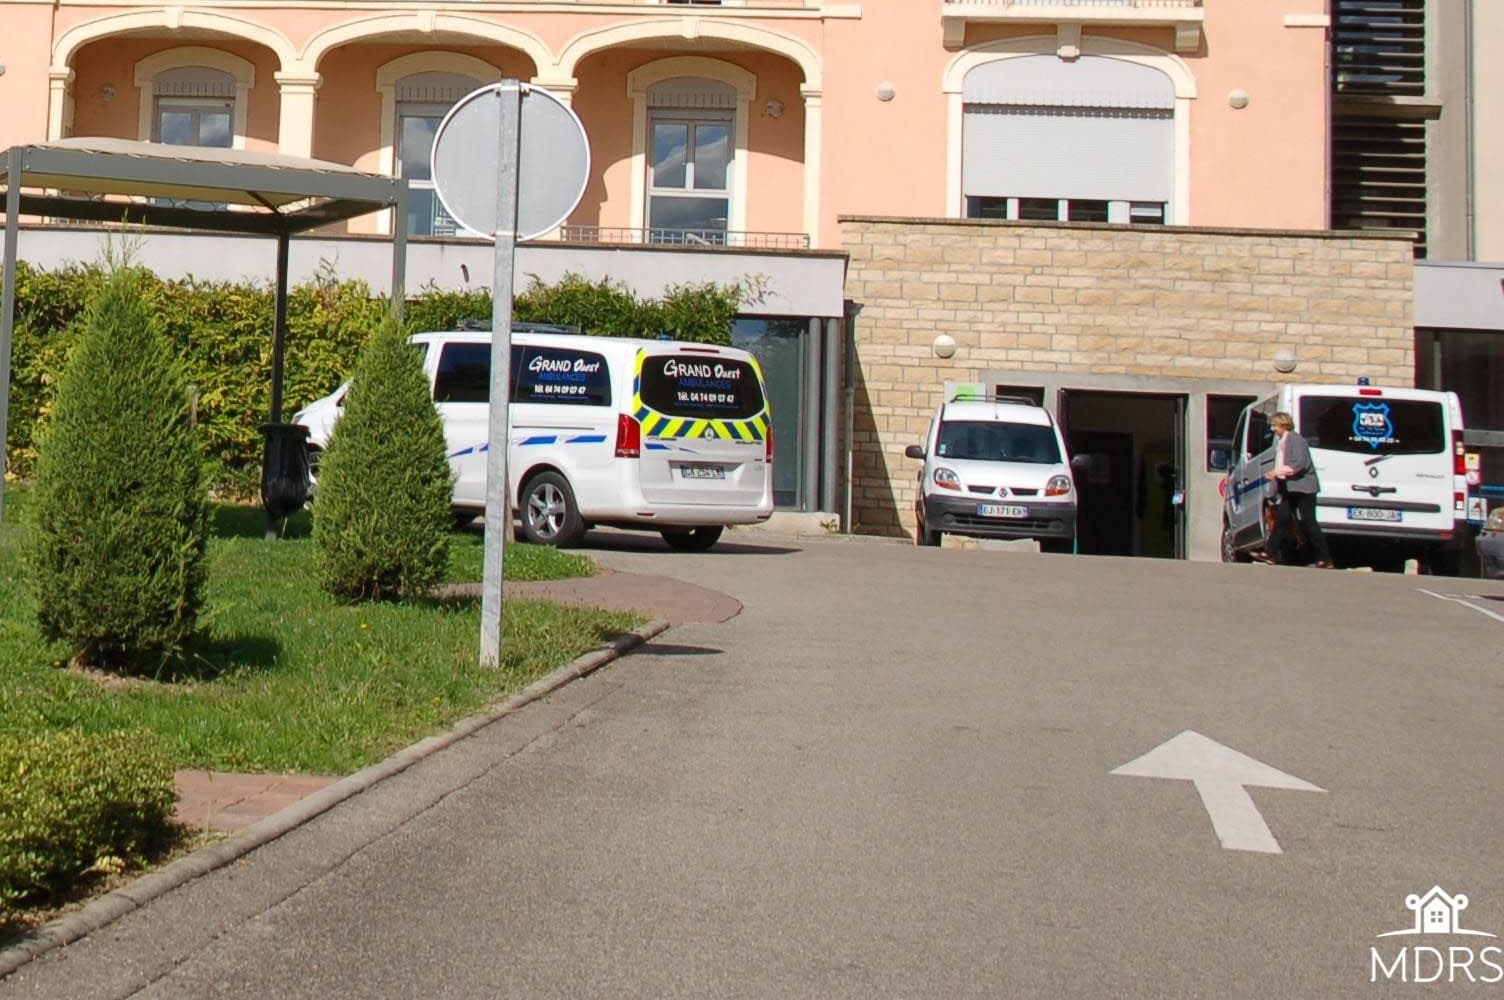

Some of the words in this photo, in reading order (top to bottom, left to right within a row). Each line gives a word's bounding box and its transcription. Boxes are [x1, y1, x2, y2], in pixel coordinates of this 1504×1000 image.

[528, 355, 571, 373] GRAND
[573, 358, 601, 373] Ouest
[663, 359, 712, 378] GRAND
[713, 363, 741, 379] Ouest
